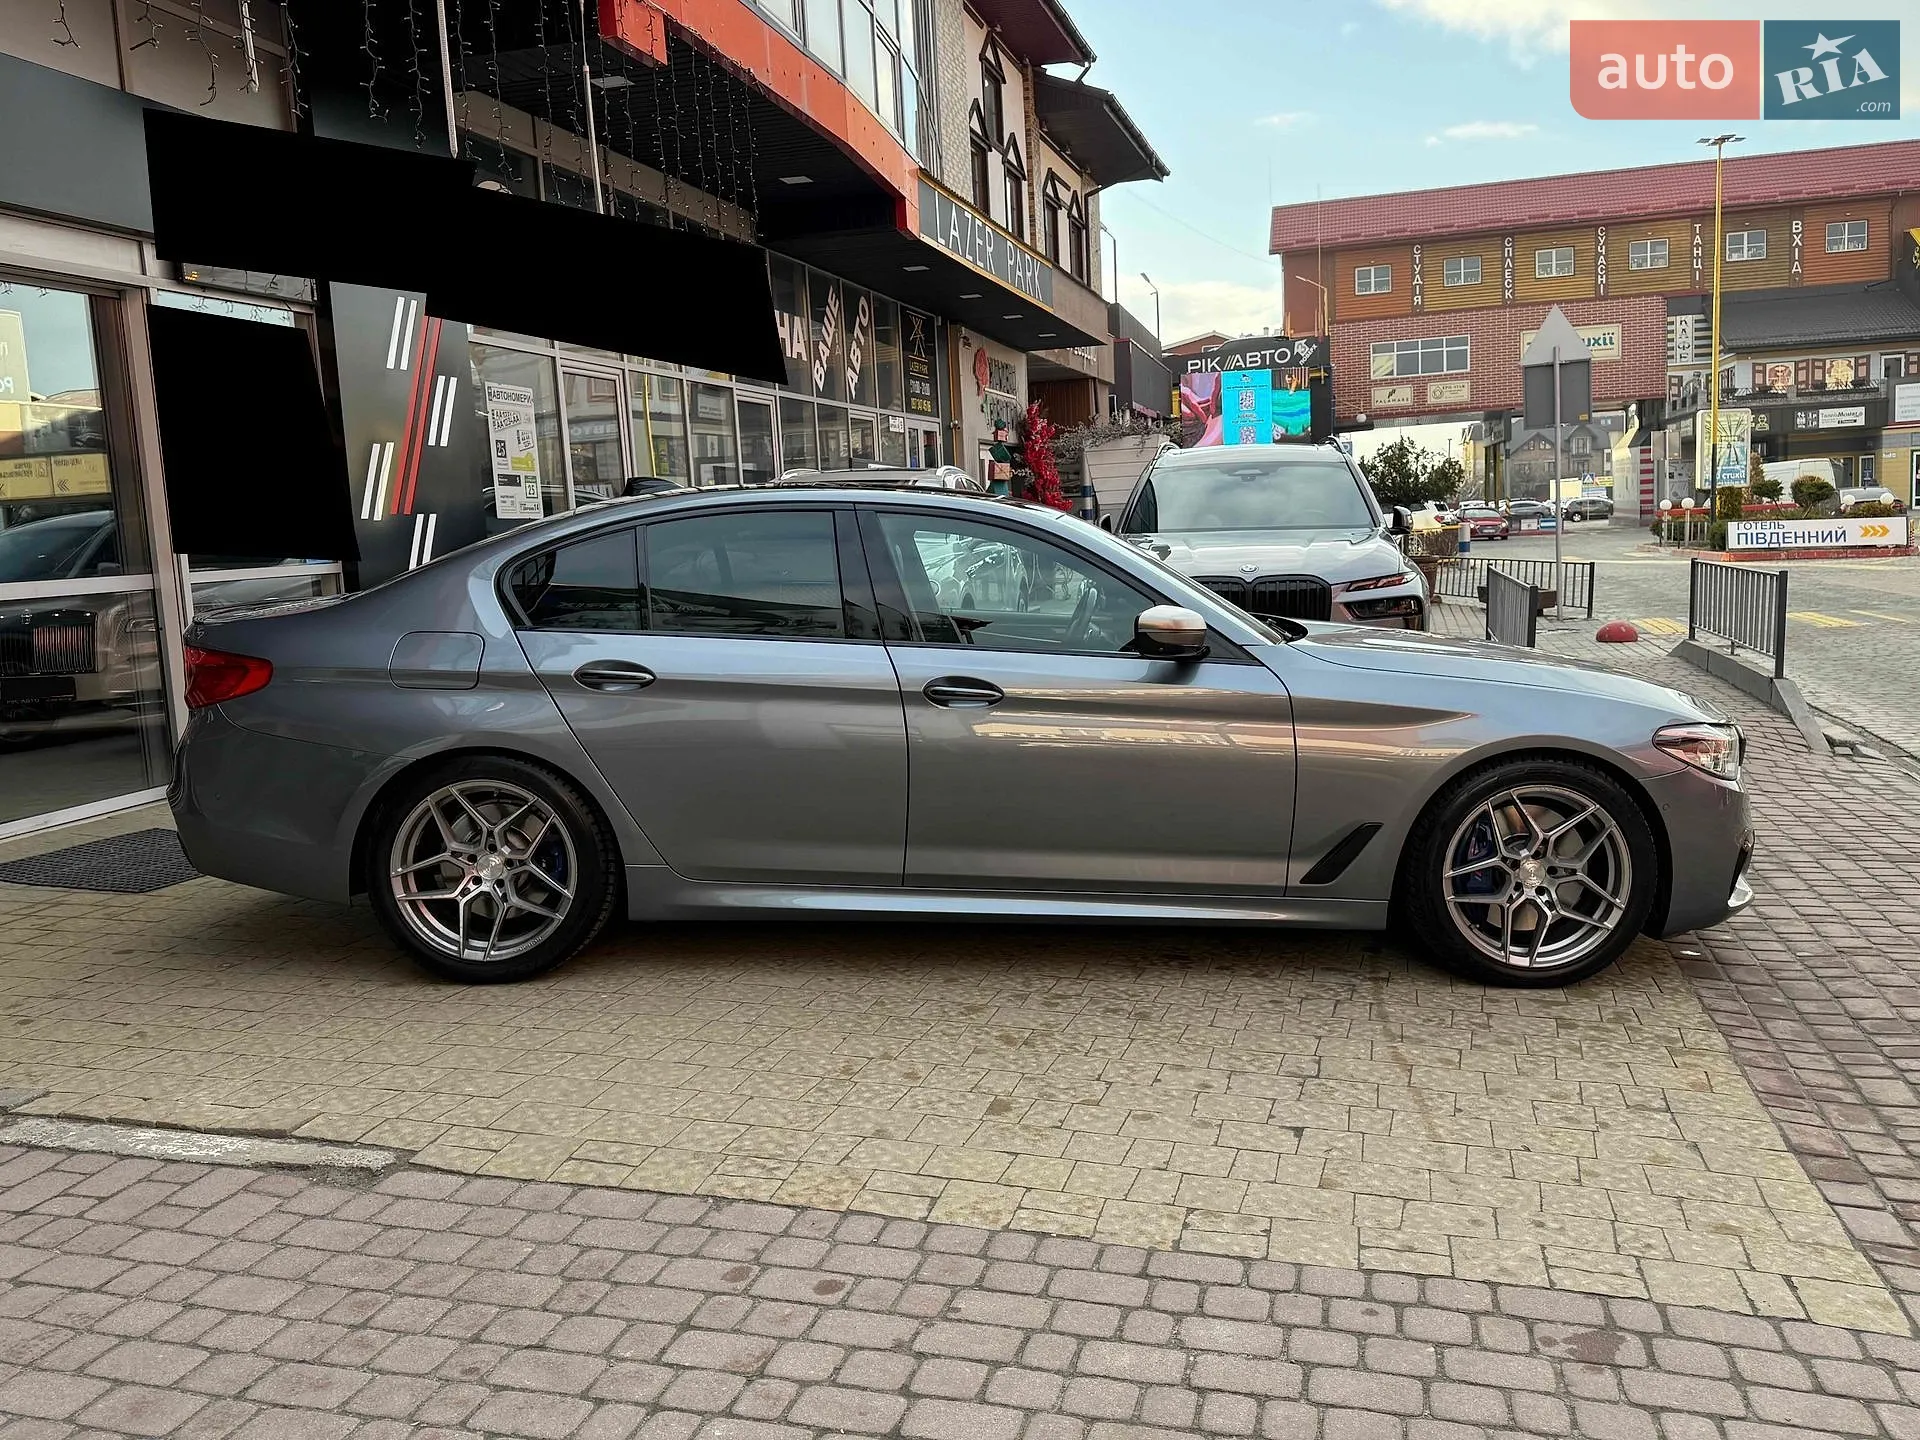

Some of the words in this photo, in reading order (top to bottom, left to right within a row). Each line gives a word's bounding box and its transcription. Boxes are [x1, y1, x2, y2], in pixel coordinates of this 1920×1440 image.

[935, 191, 995, 274] LAZER
[1006, 240, 1042, 301] PARK
[1413, 245, 1423, 305] СТУДІЯ
[1504, 237, 1513, 299] СПЛЕСК
[1597, 226, 1606, 296] СУЧАСНІ
[1693, 223, 1702, 281] ТАНЦІ
[814, 285, 839, 392] ВАШЕ
[847, 296, 869, 399] АВТО
[1737, 526, 1847, 547] ПІВДЕННИЙ
